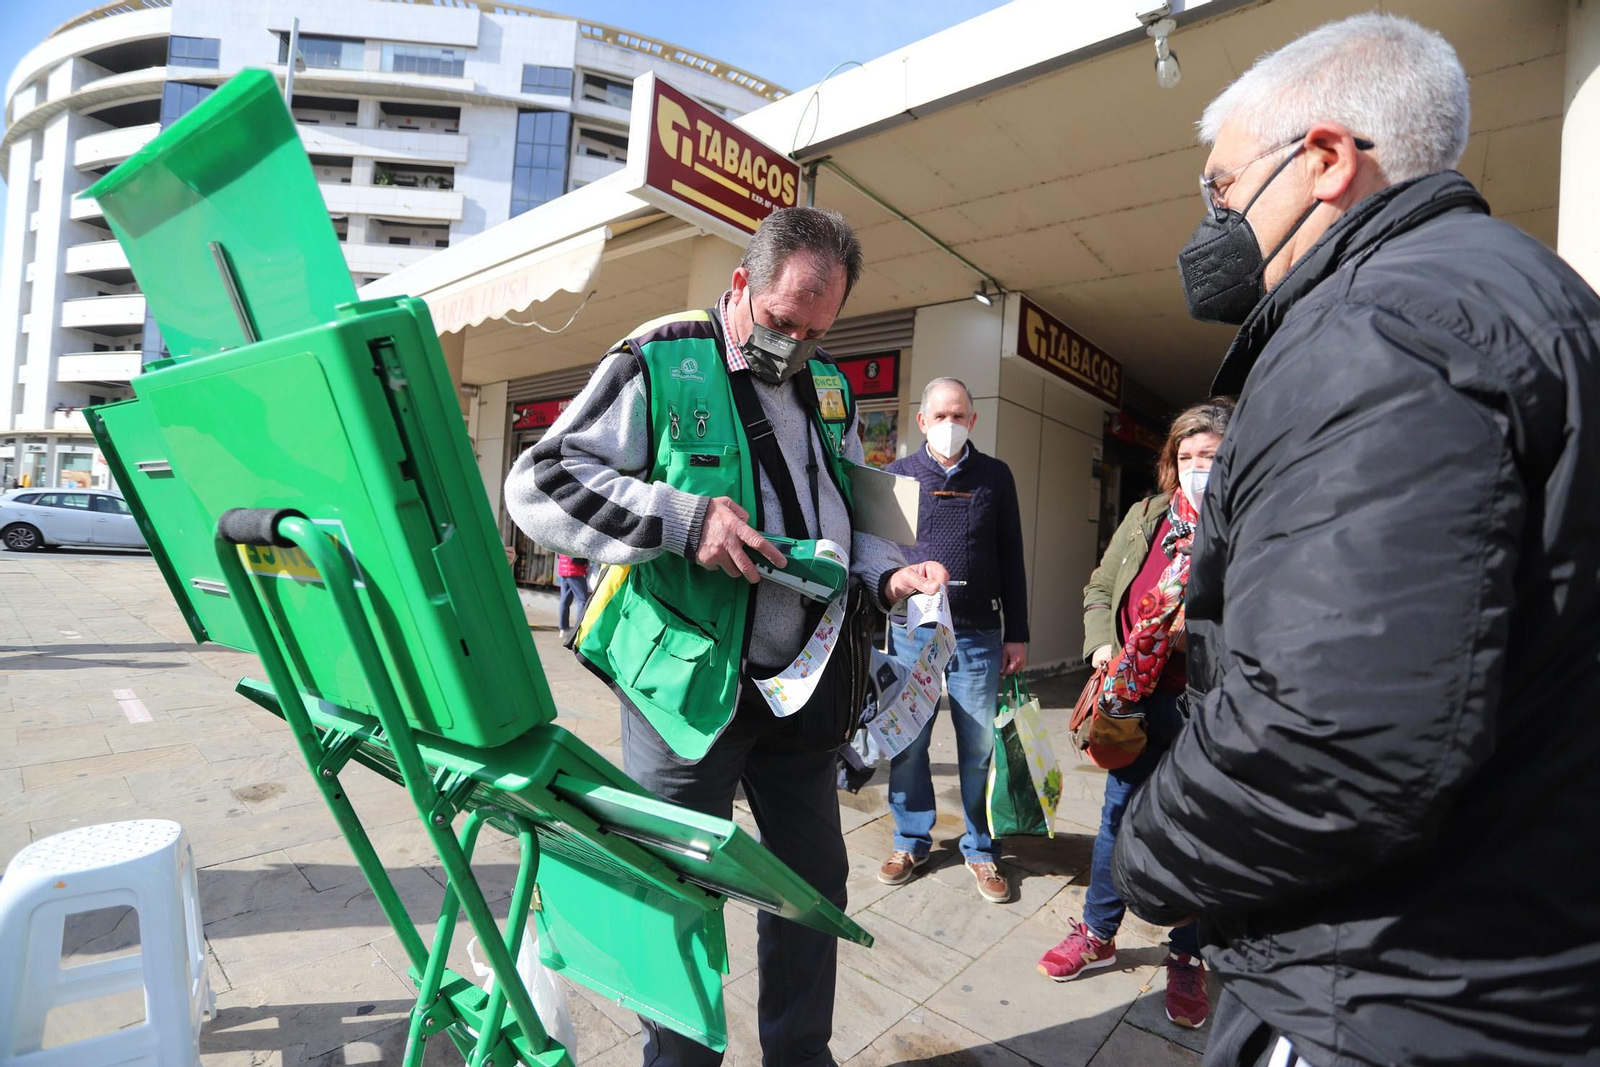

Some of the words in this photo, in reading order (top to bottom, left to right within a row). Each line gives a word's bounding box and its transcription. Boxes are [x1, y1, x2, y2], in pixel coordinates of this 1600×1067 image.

[696, 119, 796, 206] TABACOS
[815, 378, 839, 387] ONCE
[1048, 325, 1119, 392] TABACOS
